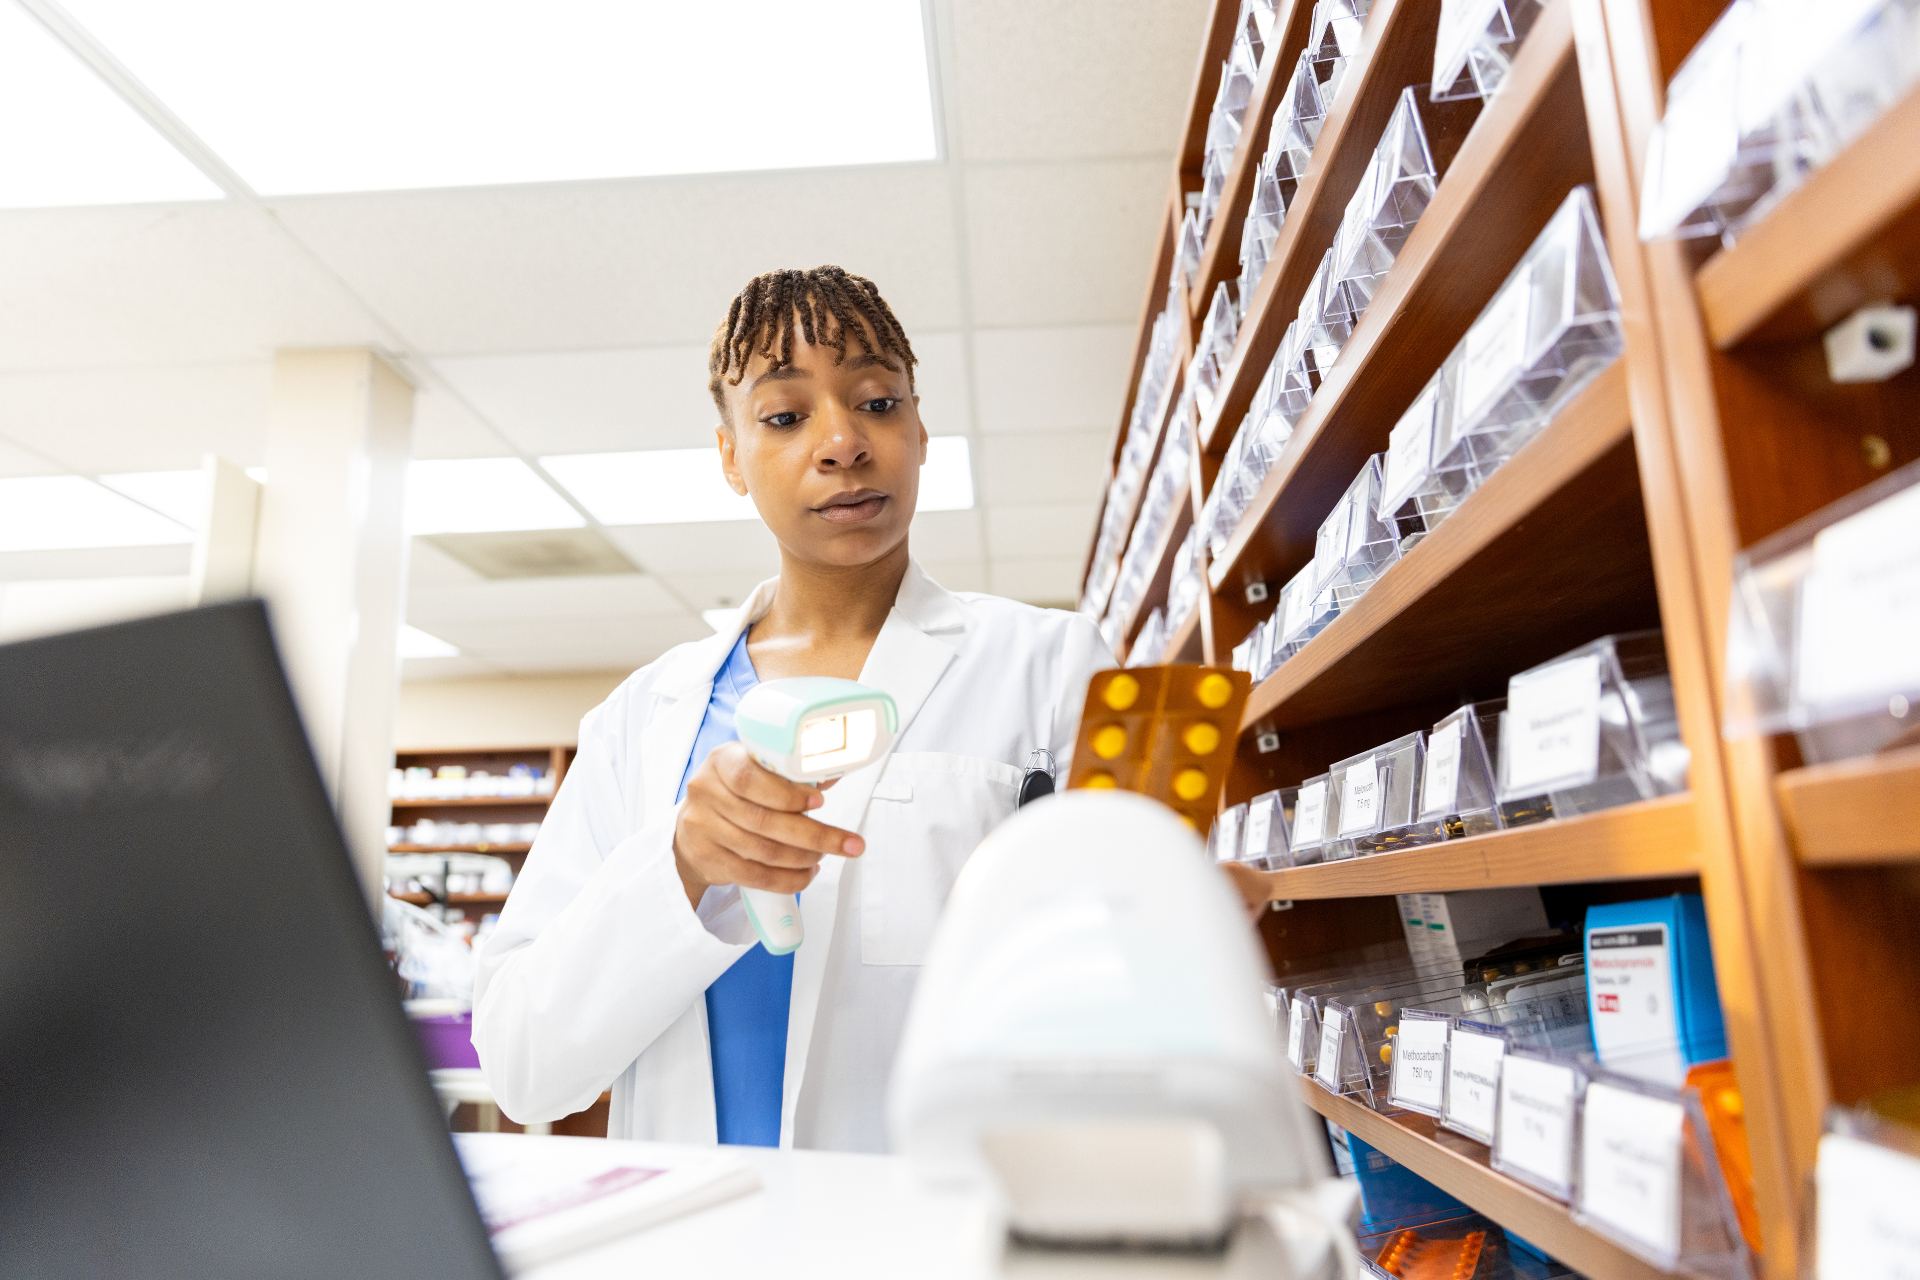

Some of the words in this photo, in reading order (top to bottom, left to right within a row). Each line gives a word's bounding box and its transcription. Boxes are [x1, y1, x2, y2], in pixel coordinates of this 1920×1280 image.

[1402, 1049, 1443, 1061] Methocarbamo
[1412, 1066, 1423, 1079] 750
[1424, 1068, 1433, 1082] mg
